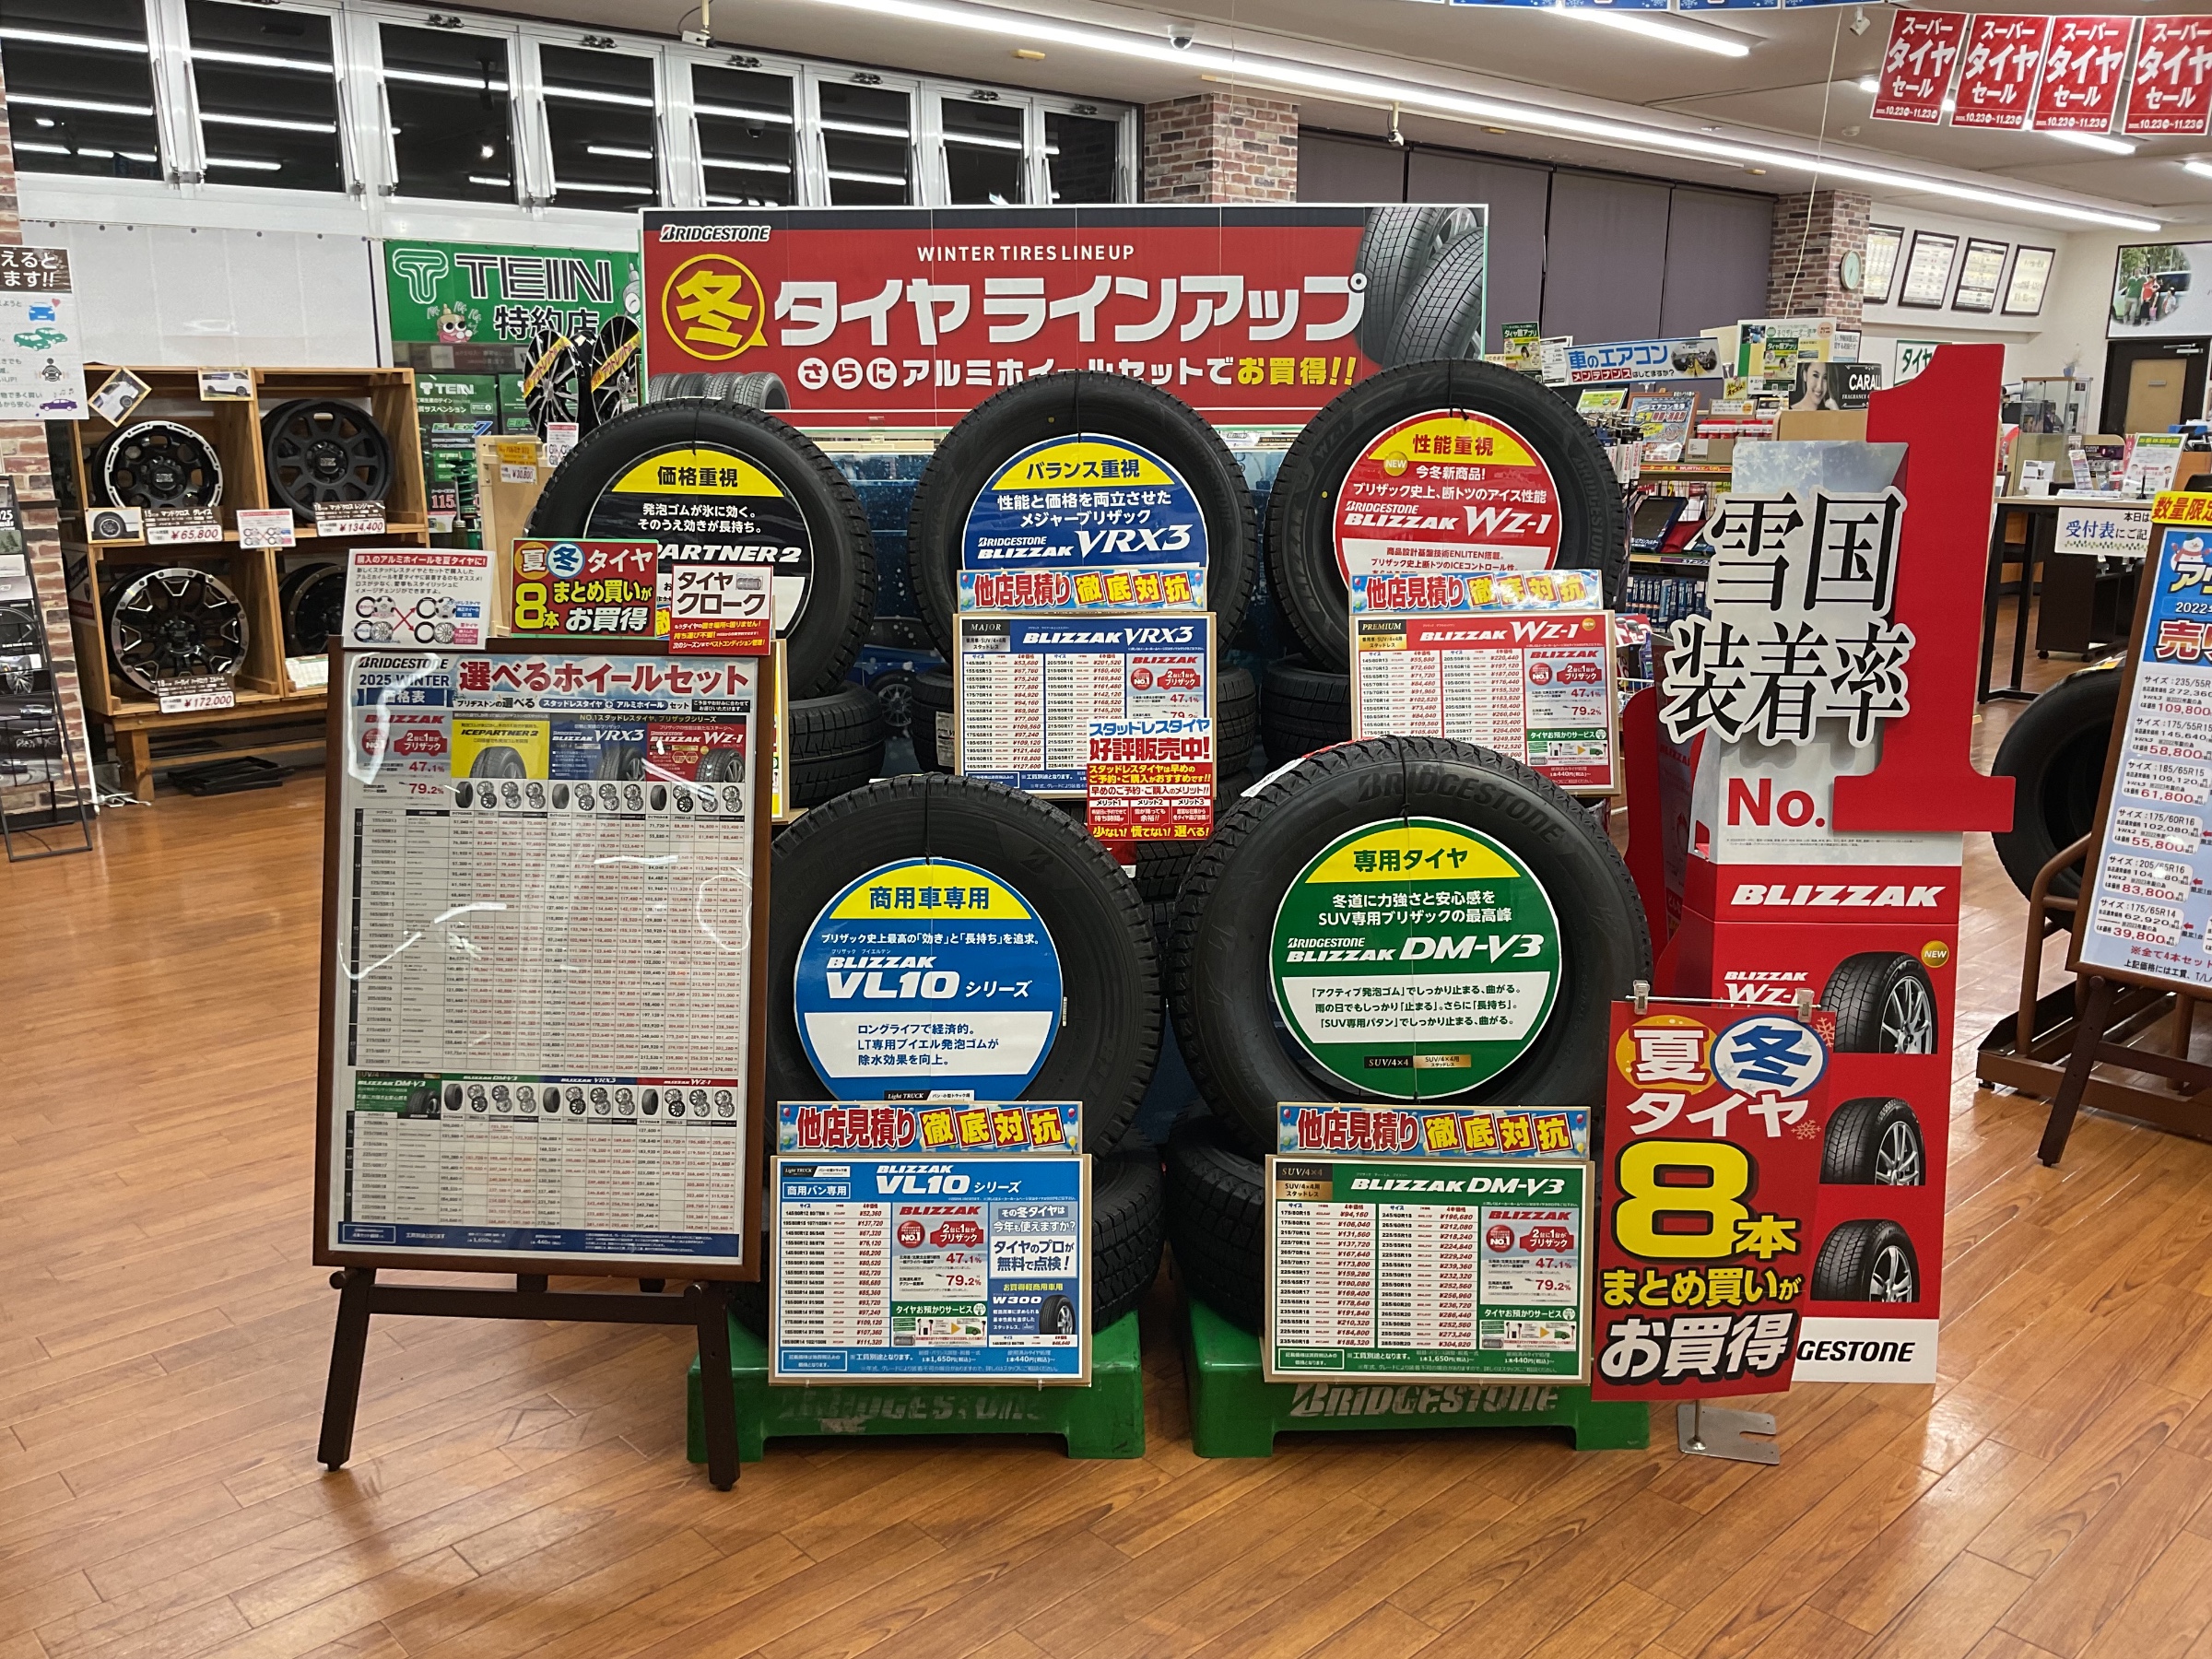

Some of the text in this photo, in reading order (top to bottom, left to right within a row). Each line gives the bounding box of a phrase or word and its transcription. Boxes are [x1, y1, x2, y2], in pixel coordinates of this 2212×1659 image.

[1902, 17, 1953, 35] スーパー
[1982, 21, 2035, 39] スーパー
[2061, 23, 2118, 41] スーパー
[2152, 23, 2212, 41] スーパー
[1887, 38, 1956, 76] タイヤ
[1966, 42, 2039, 81] タイヤ
[2046, 45, 2124, 84] タイヤ
[2137, 46, 2212, 84] タイヤ
[1892, 76, 1934, 98] セール
[1972, 83, 2017, 103] セール
[2054, 87, 2100, 107] セール
[2147, 87, 2196, 109] セール
[660, 225, 771, 242] BRIDGESTONE
[1, 250, 57, 269] えると
[917, 244, 1135, 262] WINTER TIRES LINEUP
[4, 271, 53, 287] ます!!
[453, 253, 614, 303] TEIN
[676, 268, 1368, 346] 冬 タイヤラインアップ
[1570, 346, 1668, 370] 車のエアコン
[435, 383, 475, 395] TEIN
[1412, 434, 1494, 457] 性能重視
[1026, 459, 1140, 480] バランス重視
[1385, 458, 1407, 468] NEW
[657, 465, 738, 488] 価格重視
[1416, 465, 1486, 481] 今冬新商品!
[996, 490, 1172, 511] 性能と価格を両立させた
[1353, 482, 1547, 504] ブリザック史上、断トツのアイス性能
[642, 503, 756, 519] 発泡ゴムが氷に効く。
[1345, 500, 1419, 514] BRIDGESTONE
[638, 518, 761, 534] そのうえ効きが長持ち。
[1019, 509, 1151, 528] メジャーブリザック
[1344, 513, 1459, 531] BLIZZAK
[2124, 512, 2149, 523] 本日は
[171, 529, 218, 540] ¥65,800
[339, 522, 383, 532] ¥134,400
[977, 536, 1047, 547] BRIDGESTONE
[977, 524, 1194, 559] BLIZZAK VRX3
[1712, 492, 1900, 612] 雪国
[677, 571, 734, 591] タイヤ
[973, 571, 1194, 607] 他店見積り 徹底対抗
[552, 580, 653, 605] まとめ買いが
[1366, 577, 1464, 610] 他店見積り
[677, 593, 766, 616] クローク
[565, 605, 651, 633] お買得
[971, 624, 1002, 632] MAJOR
[1022, 626, 1194, 645] BLIZZAK VRX3
[1419, 630, 1508, 641] BLIZZAK
[1530, 650, 1599, 659] BLIZZAK
[359, 675, 449, 687] 2025 WINTER
[460, 661, 749, 697] 選べるホイールセット
[1667, 621, 1910, 741] 装着率
[184, 697, 232, 708] ¥172,000
[594, 730, 645, 742] VRX3
[1089, 719, 1210, 736] スタッドレスタイヤ
[1089, 736, 1210, 761] 好評販売中!
[1089, 764, 1195, 773] スタッドレスタイヤは早めの
[1093, 825, 1209, 838] 少ない! 慌てない! 選べる!
[1353, 847, 1469, 872] 専用タイヤ
[869, 887, 990, 910] 商用車専用
[1333, 890, 1495, 908] 冬道に力強さと安心感を
[1732, 884, 1947, 908] BLIZZAK
[1319, 907, 1512, 926] SUV専用ブリザックの最高峰
[821, 933, 1040, 945] ブリザック史上最高の「効き」と「長持ち」を追求。
[1288, 936, 1365, 948] BRIDGESTONE
[1286, 934, 1546, 964] BLIZZAK DM-V3
[1924, 948, 1947, 959] NEW
[827, 957, 937, 968] BLIZZAK
[827, 971, 1032, 999] VL10 シリーズ
[1724, 971, 1808, 982] BLIZZAK
[1312, 983, 1521, 997] 「アクティブ発泡ゴム」でしっかり止まる、曲がる。
[1314, 1000, 1518, 1014] 雨の日でもしっかり「止まる」。さらに「長持ち」。
[858, 1024, 975, 1035] ロングライフで経済的。
[1320, 1016, 1513, 1030] 「SUV専用パタン」でしっかり止まる、曲がる。
[858, 1039, 998, 1051] LT専用ブイエル発泡ゴムが
[858, 1054, 949, 1066] 除水効果を向上。
[1628, 1094, 1809, 1139] タイヤ
[797, 1107, 1065, 1148] 他店見積り 徹底対抗
[1298, 1111, 1574, 1152] 他店見積り 徹底対抗
[877, 1165, 953, 1173] BLIZZAK
[787, 1185, 847, 1196] 商用バン専用
[877, 1175, 1021, 1194] VL10 シリーズ
[1350, 1177, 1565, 1197] BLIZZAK DM-V3
[900, 1206, 982, 1215] BLIZZAK
[1002, 1206, 1065, 1218] その冬タイヤは
[1488, 1210, 1572, 1220] BLIZZAK
[994, 1220, 1076, 1233] 今年も使えますか?
[940, 1234, 978, 1242] ブリザック
[994, 1240, 1074, 1254] タイヤのプロが
[947, 1253, 982, 1264] 47.1%
[997, 1256, 1069, 1271] 無料で点検!
[947, 1276, 982, 1286] 79.2%
[1603, 1266, 1802, 1307] まとめ買いが
[993, 1296, 1041, 1304] W300
[897, 1305, 972, 1314] タイヤお預かりサービス
[1484, 1309, 1562, 1319] タイヤお預かりサービス
[1600, 1312, 1794, 1380] お買得
[1796, 1339, 1916, 1363] GESTONE
[1290, 1382, 1559, 1417] BRIDGESTONE
